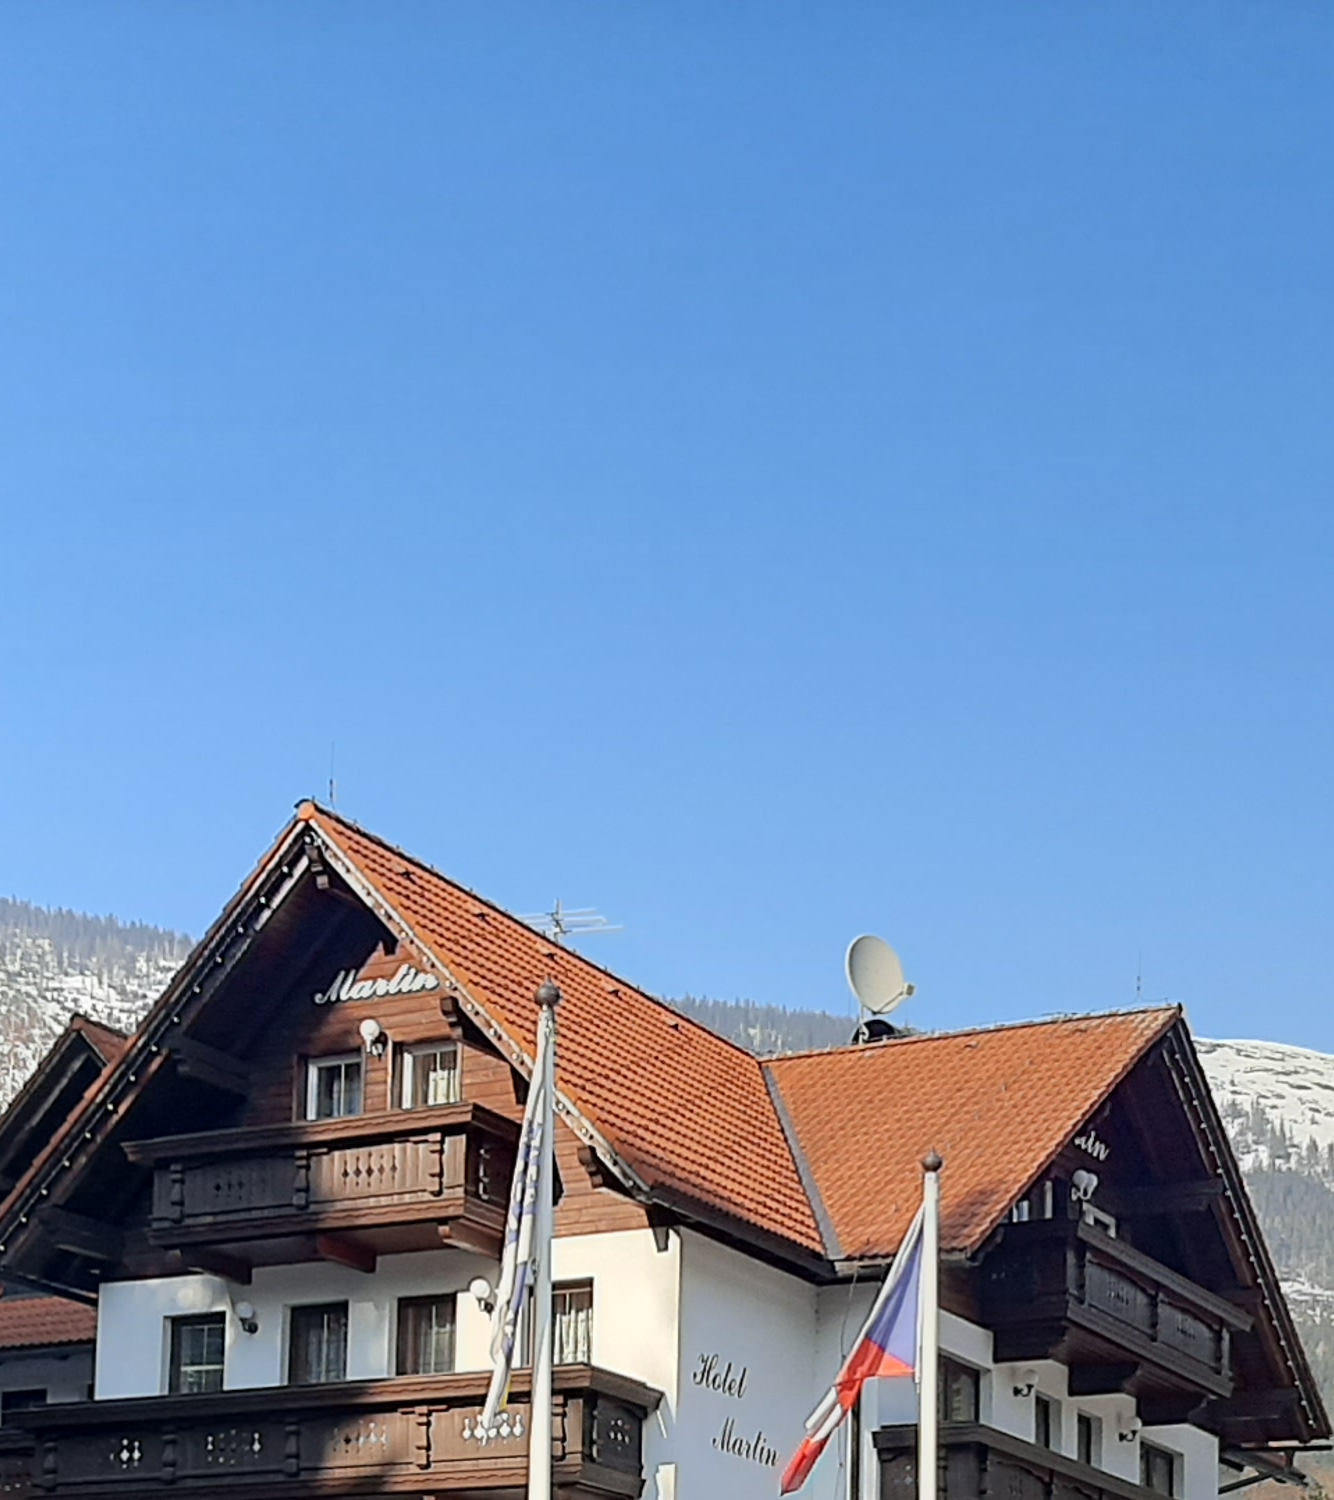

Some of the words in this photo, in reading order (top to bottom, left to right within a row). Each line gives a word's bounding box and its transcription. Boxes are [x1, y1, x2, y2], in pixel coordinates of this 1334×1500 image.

[314, 964, 440, 1004] Martin
[692, 1353, 747, 1399] Hotel
[711, 1416, 779, 1468] Martin
